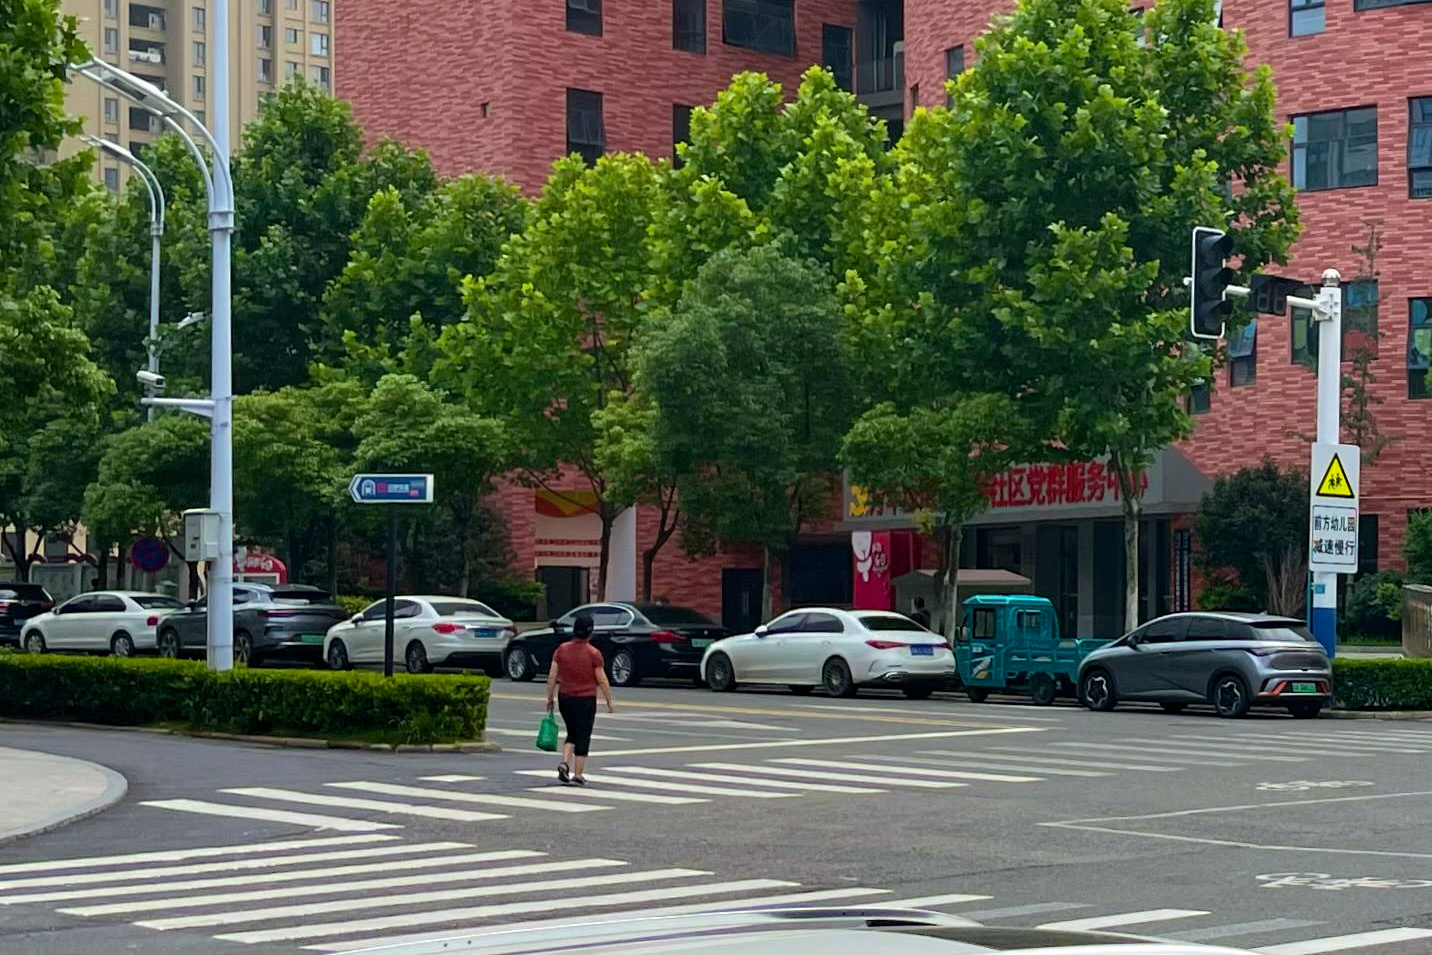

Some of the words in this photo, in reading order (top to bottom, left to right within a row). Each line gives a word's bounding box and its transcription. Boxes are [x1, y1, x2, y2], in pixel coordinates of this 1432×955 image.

[1314, 514, 1356, 533] 前方幼儿园
[1313, 538, 1356, 556] 减速慢行
